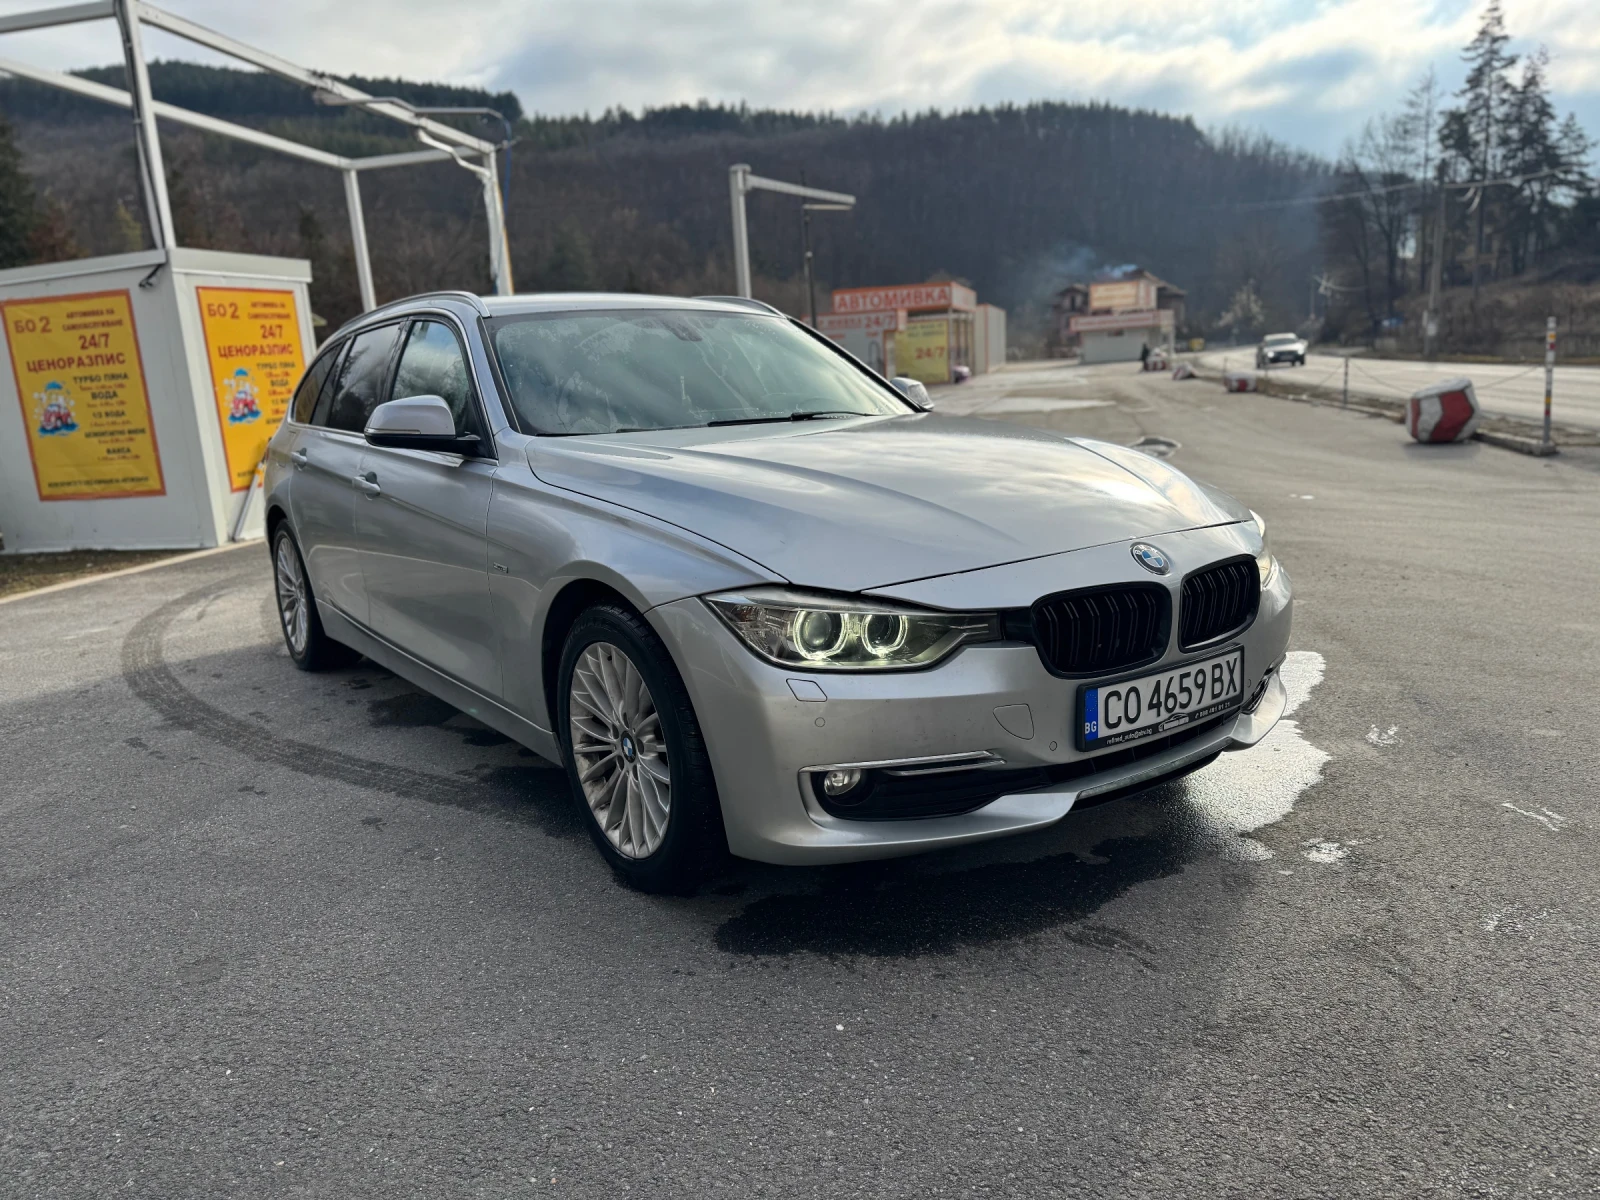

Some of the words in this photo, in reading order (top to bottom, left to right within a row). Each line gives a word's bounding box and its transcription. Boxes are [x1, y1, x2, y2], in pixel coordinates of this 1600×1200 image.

[838, 287, 949, 310] АВТОМИВКА
[206, 303, 227, 318] БО
[229, 302, 240, 319] 2
[14, 319, 37, 335] БО
[39, 316, 52, 334] 2
[78, 332, 110, 350] 24/7
[217, 343, 294, 359] ЦЕНОРАЗПИС
[26, 352, 126, 374] ЦЕНОРАЗПИС
[73, 375, 102, 385] ТУРБО
[91, 390, 118, 400] ВОДА
[1147, 668, 1207, 718] 4659
[1084, 721, 1097, 735] BG
